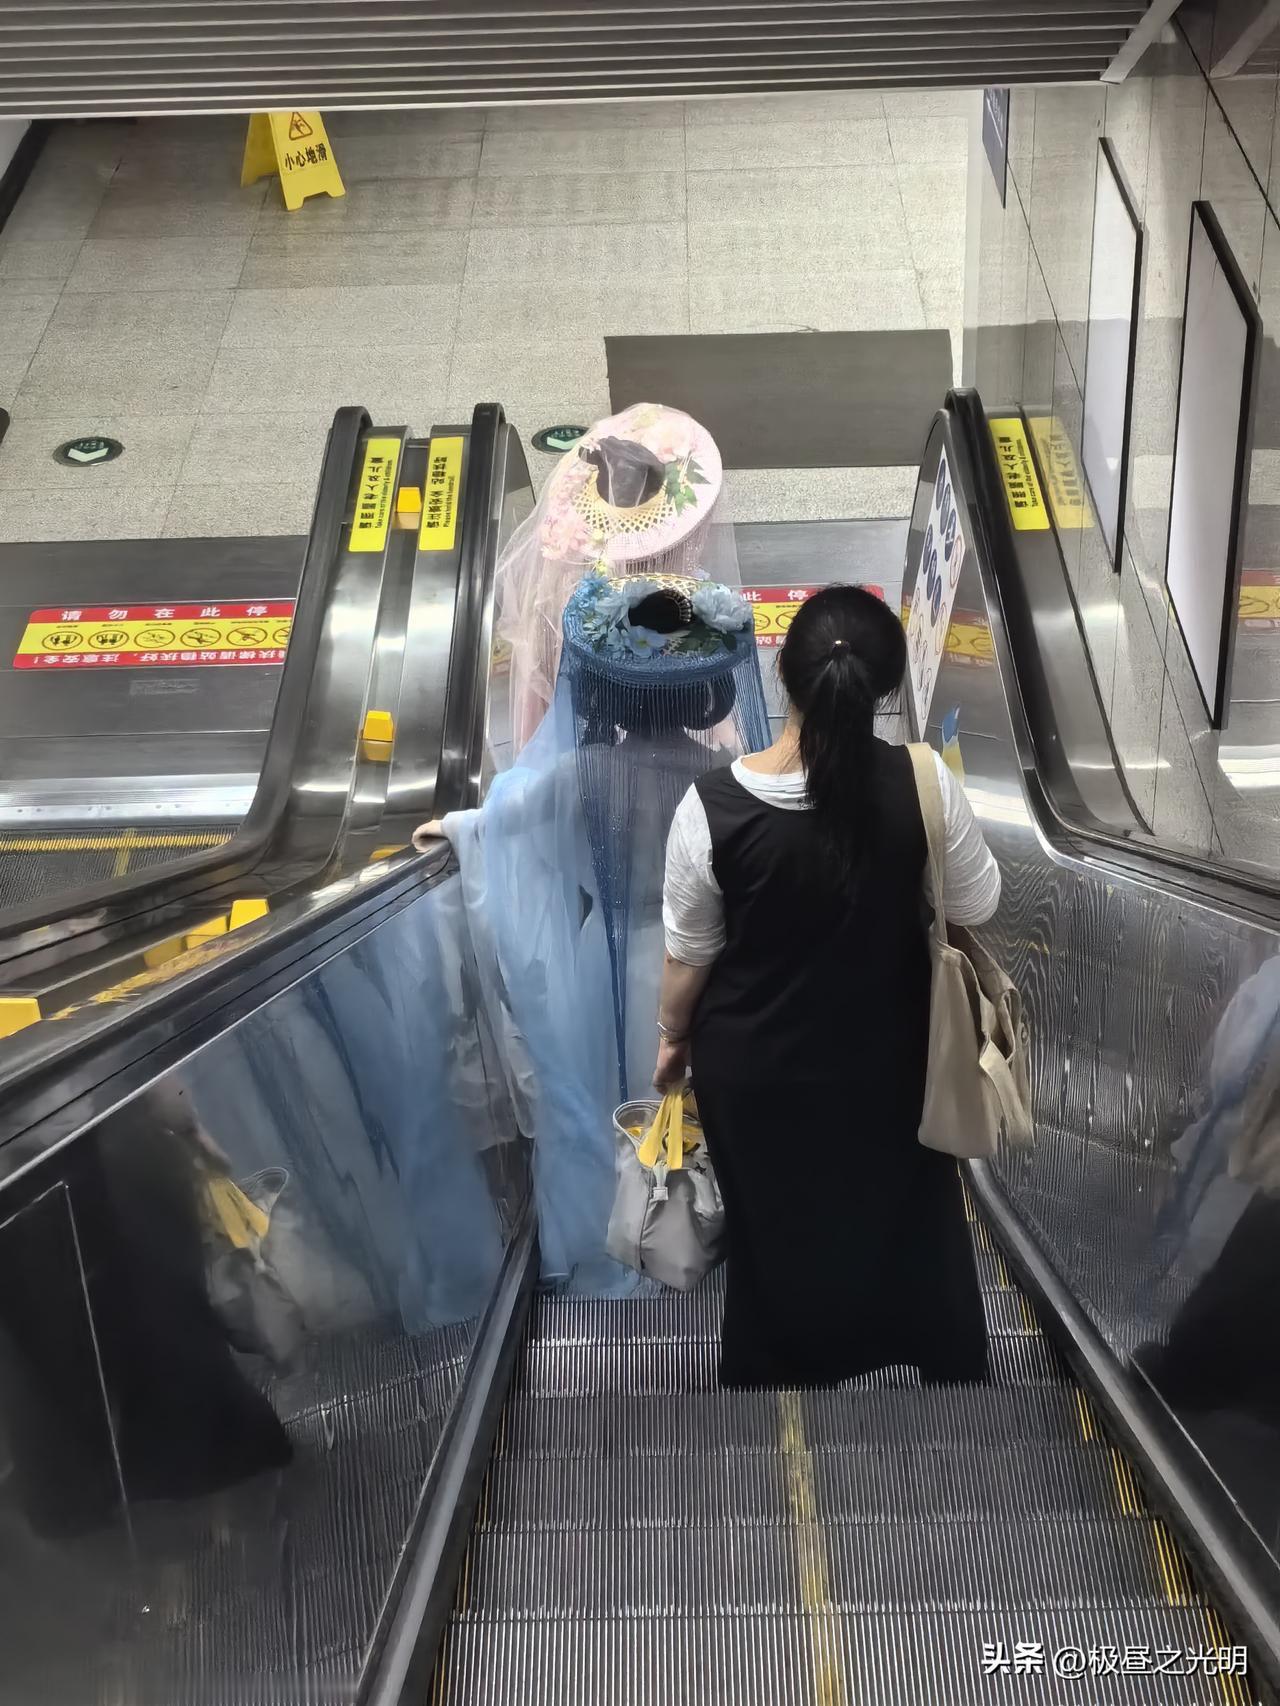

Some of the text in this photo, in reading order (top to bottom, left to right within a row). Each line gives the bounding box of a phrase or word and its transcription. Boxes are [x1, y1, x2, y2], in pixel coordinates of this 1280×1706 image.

[285, 143, 327, 171] 小心地滑
[61, 605, 268, 621] 请勿在此停
